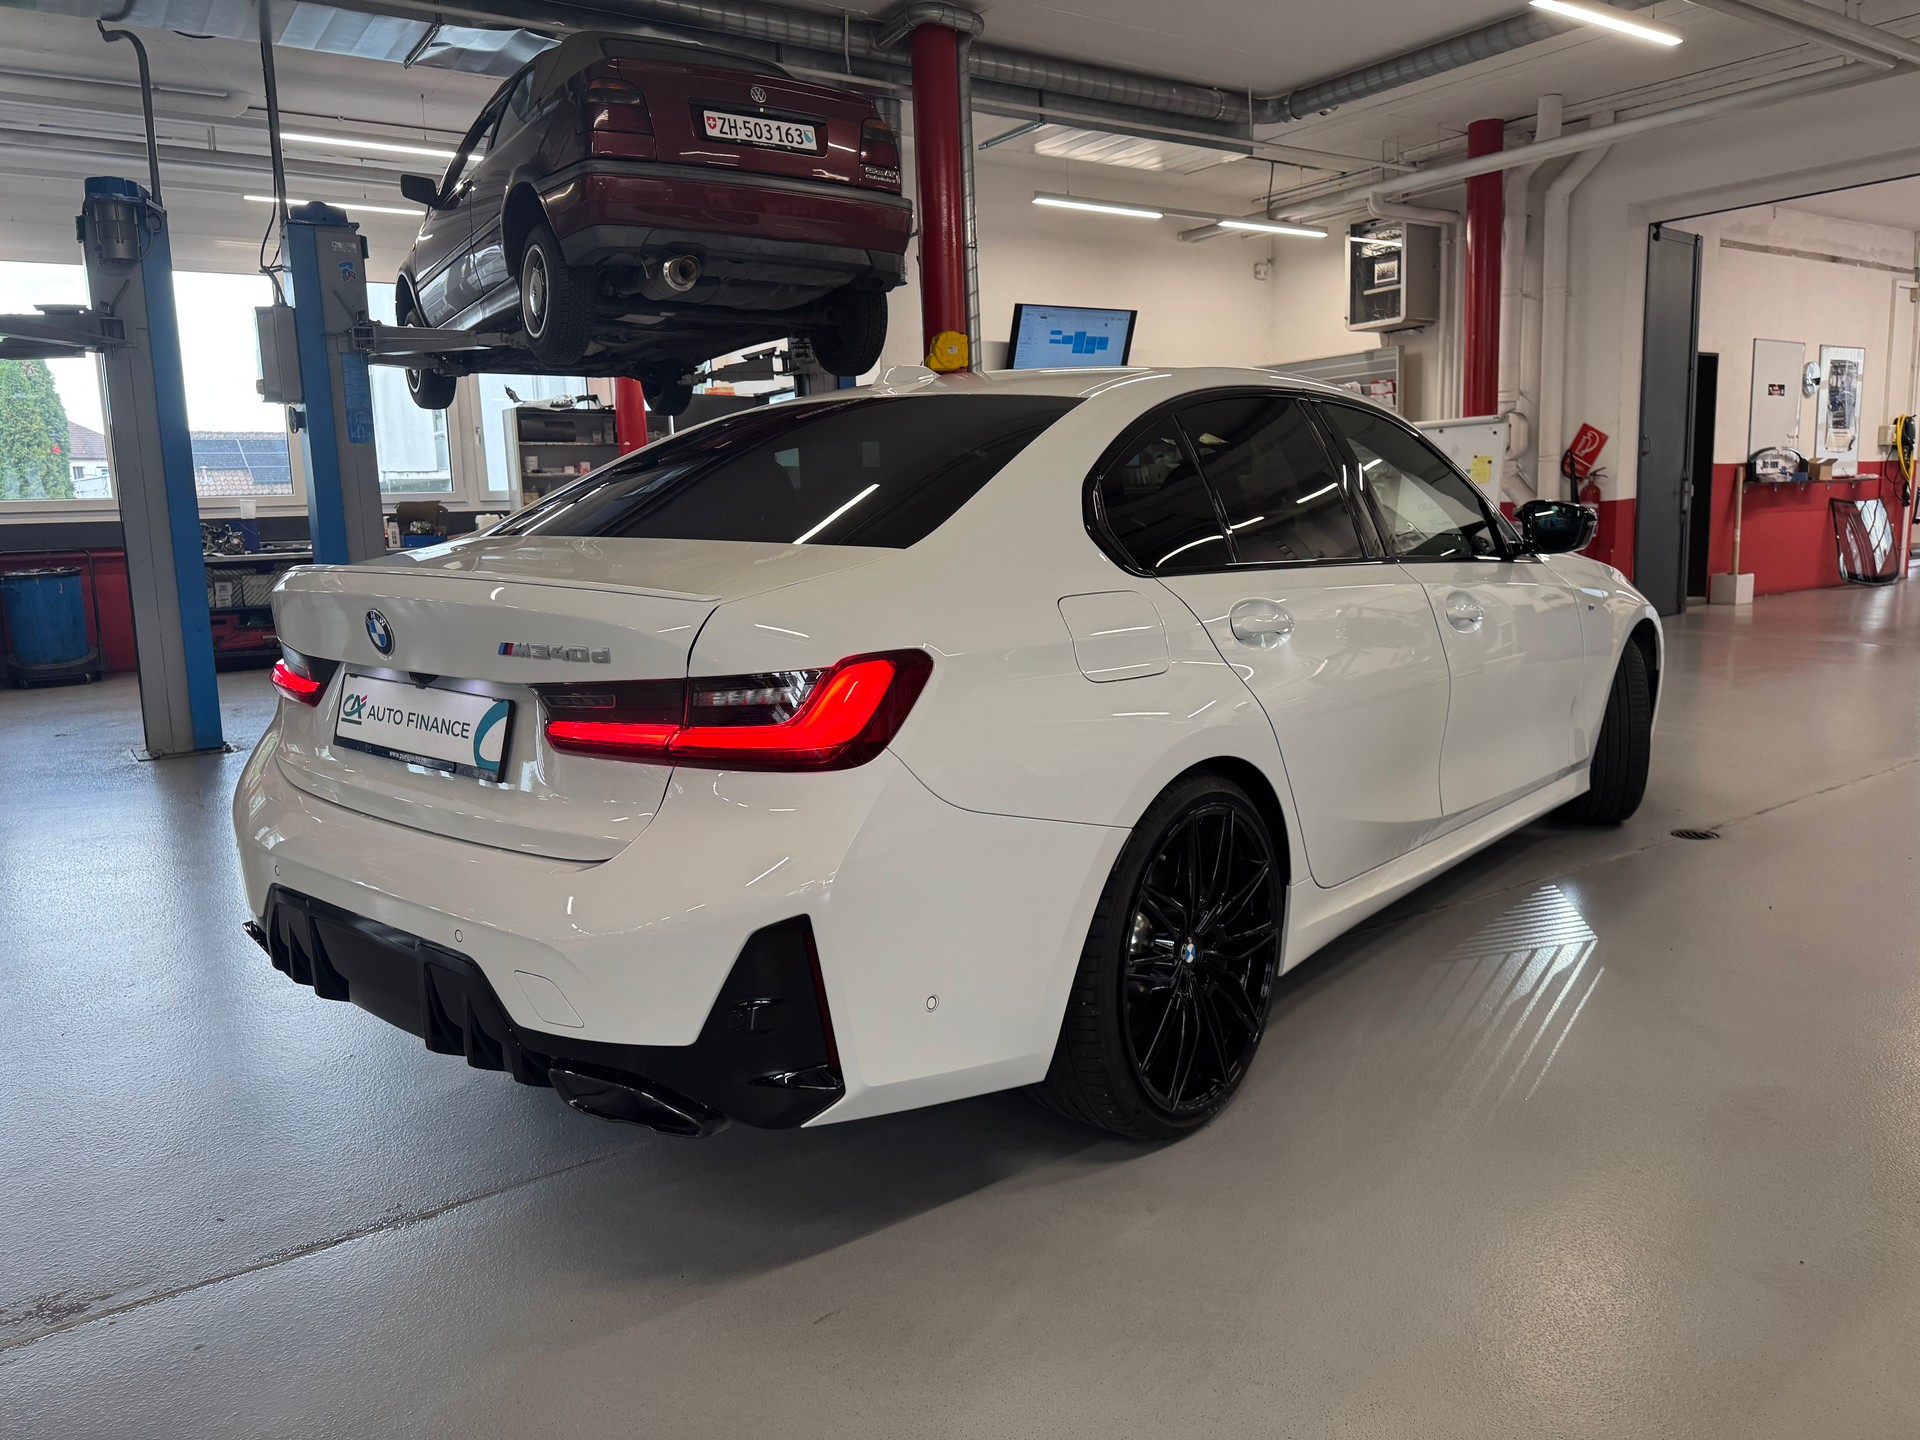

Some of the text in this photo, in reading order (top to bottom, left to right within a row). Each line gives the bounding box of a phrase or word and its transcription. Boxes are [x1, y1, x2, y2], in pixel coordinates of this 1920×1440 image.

[511, 641, 612, 664] M340d
[366, 704, 404, 726] AUTO
[406, 711, 471, 740] FINANCE
